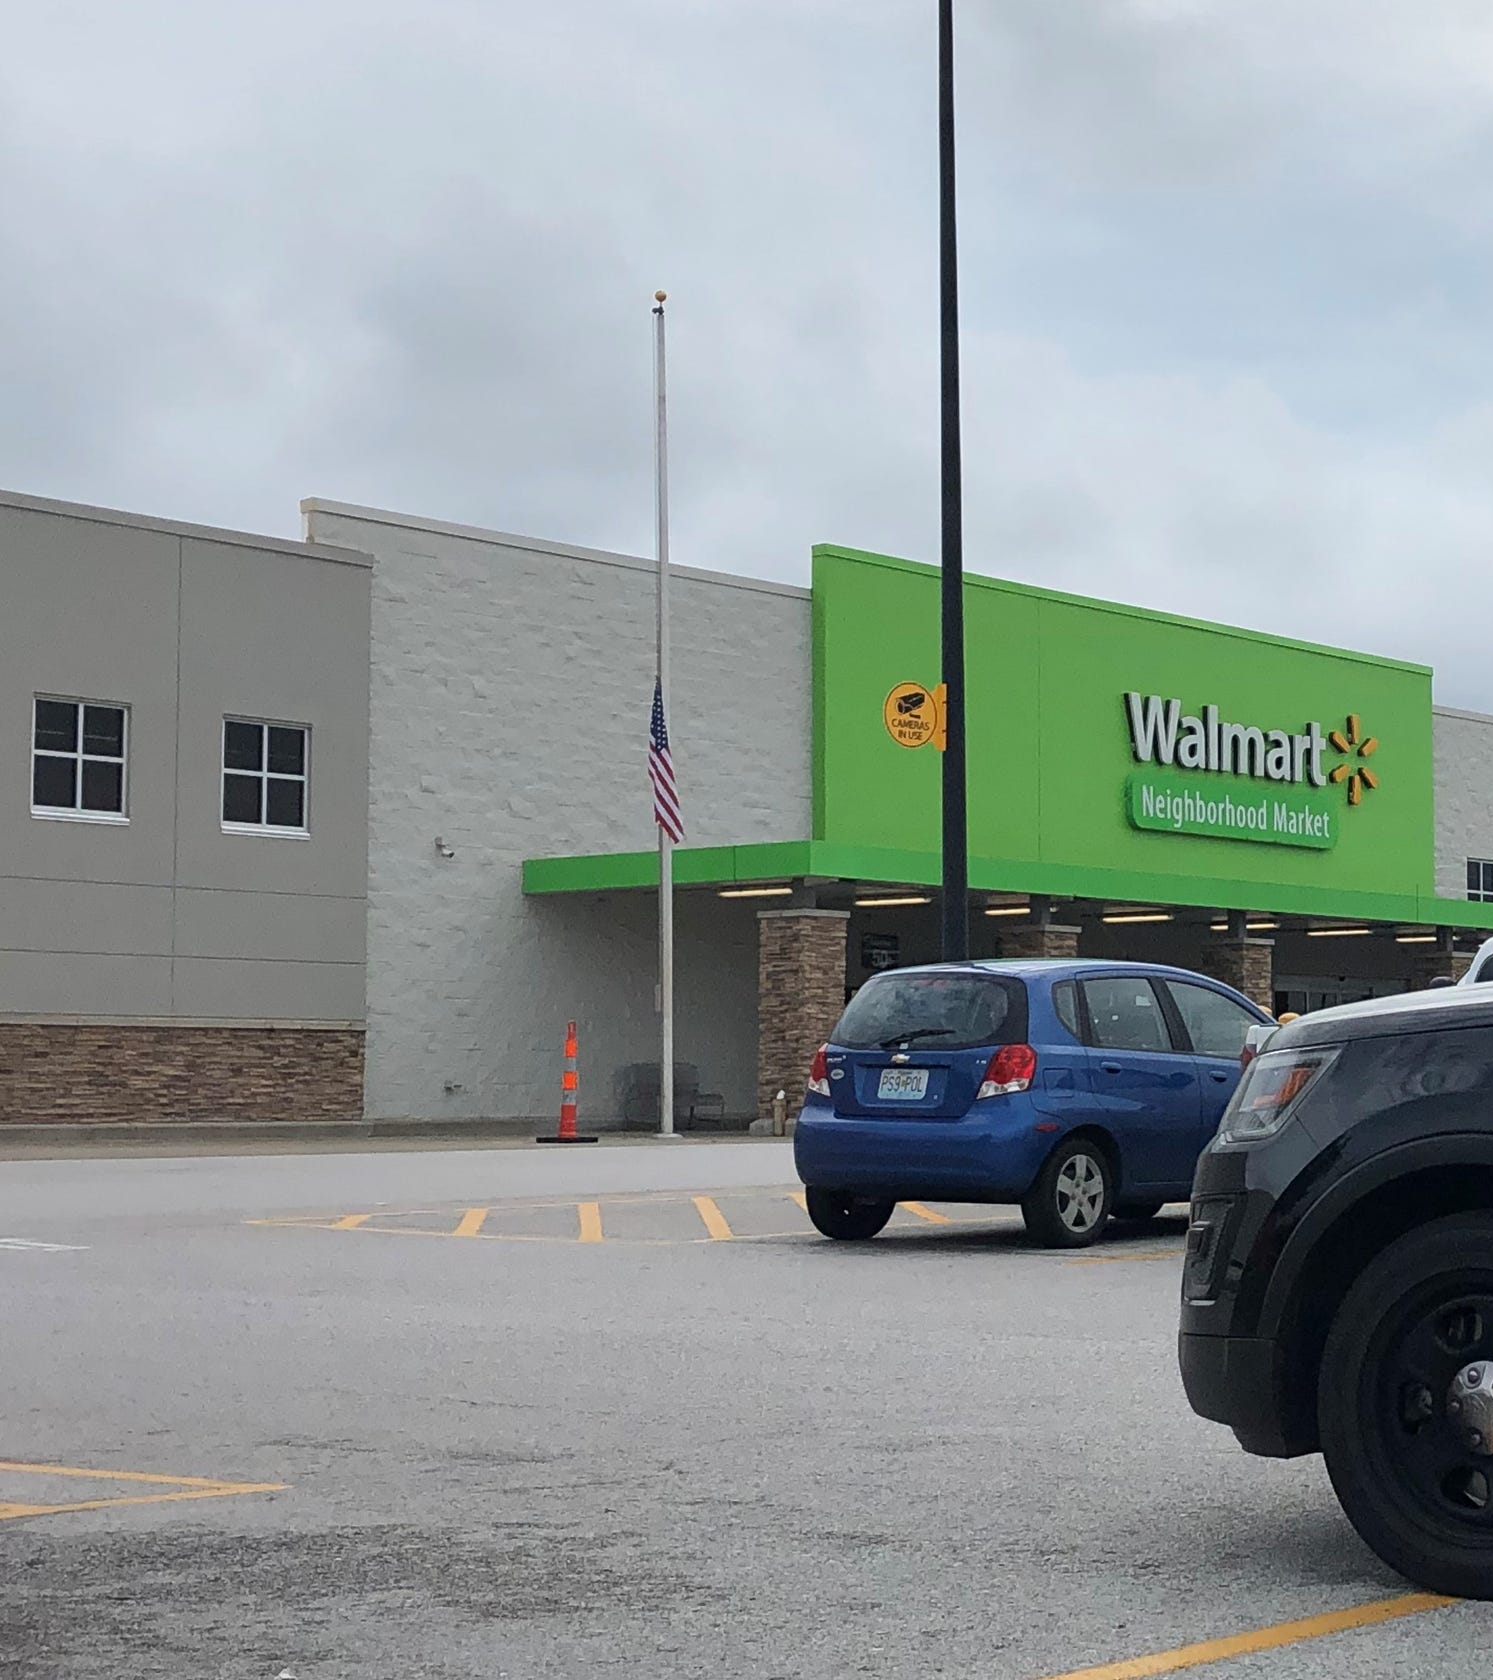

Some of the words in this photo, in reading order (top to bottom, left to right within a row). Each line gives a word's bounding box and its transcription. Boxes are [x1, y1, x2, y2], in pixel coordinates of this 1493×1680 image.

[891, 718, 930, 731] CAMERAS
[898, 730, 907, 739] IN
[908, 731, 923, 740] USE
[1124, 692, 1327, 787] Walmart
[1142, 785, 1267, 828] Neighborhood
[1273, 802, 1330, 838] Market
[881, 1075, 901, 1092] PS9
